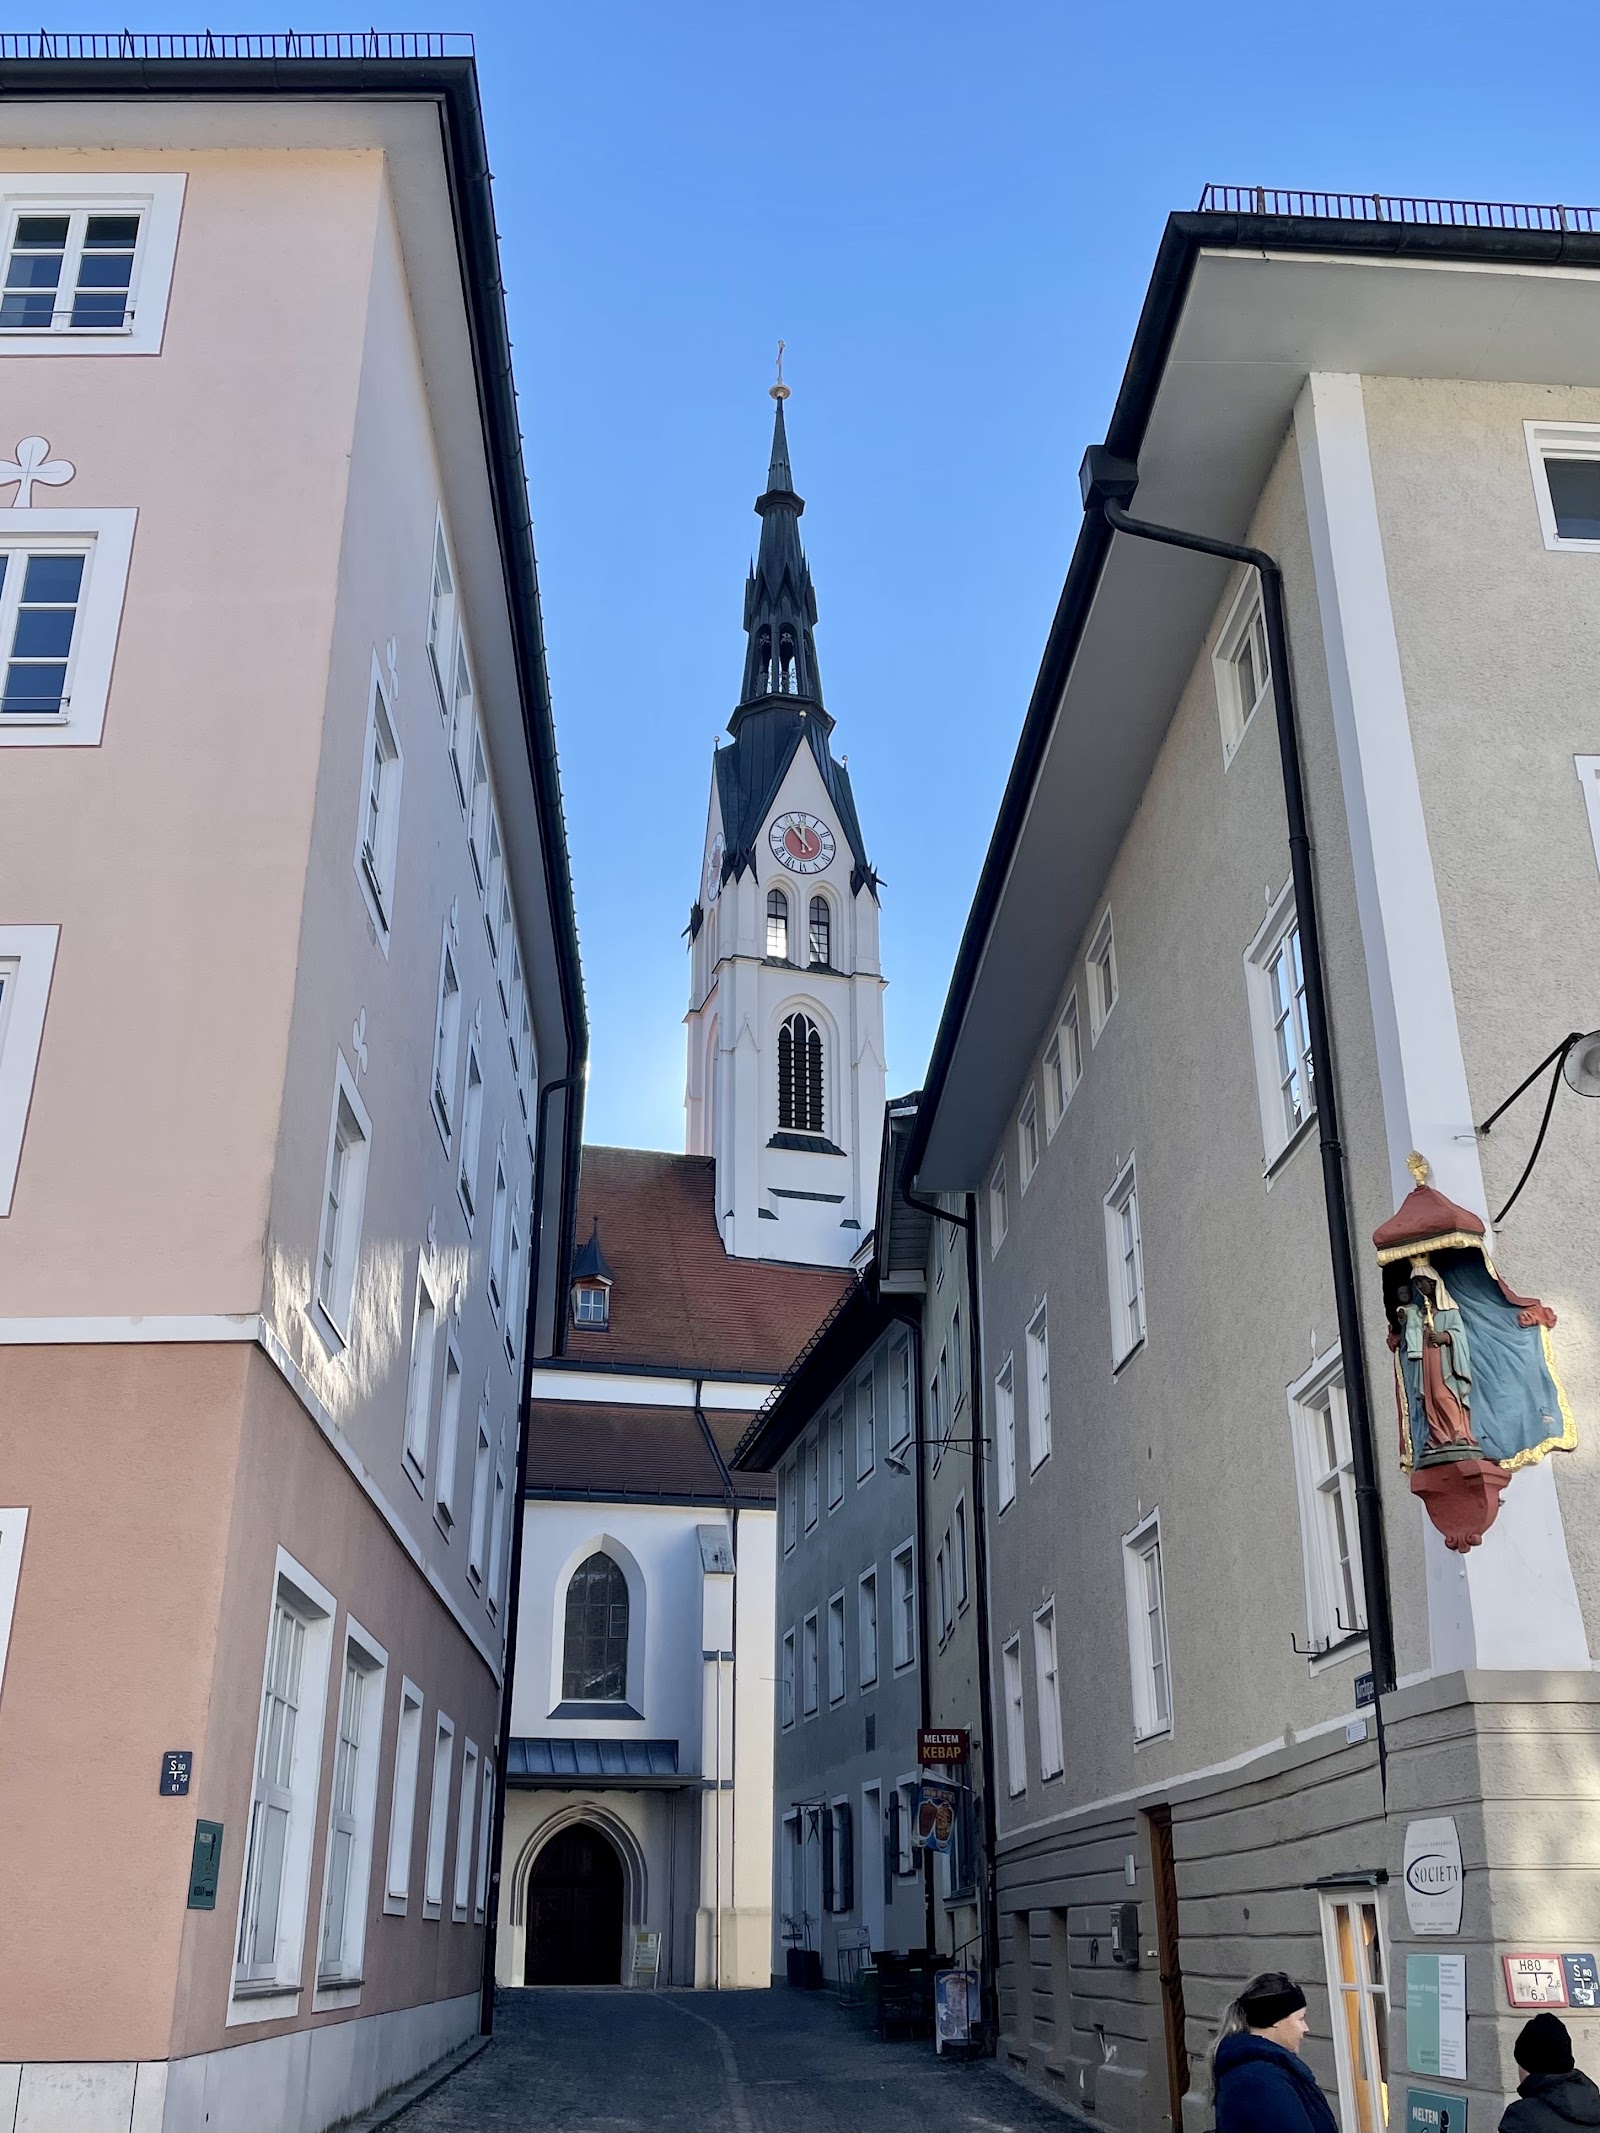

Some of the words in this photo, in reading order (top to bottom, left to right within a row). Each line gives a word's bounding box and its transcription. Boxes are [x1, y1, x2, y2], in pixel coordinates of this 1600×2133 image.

[924, 1734, 959, 1743] MELTEM
[923, 1746, 961, 1758] KEBAP
[1414, 1865, 1459, 1883] SOCIETY
[1573, 1964, 1581, 1977] S
[1412, 2105, 1439, 2125] MELTEM
